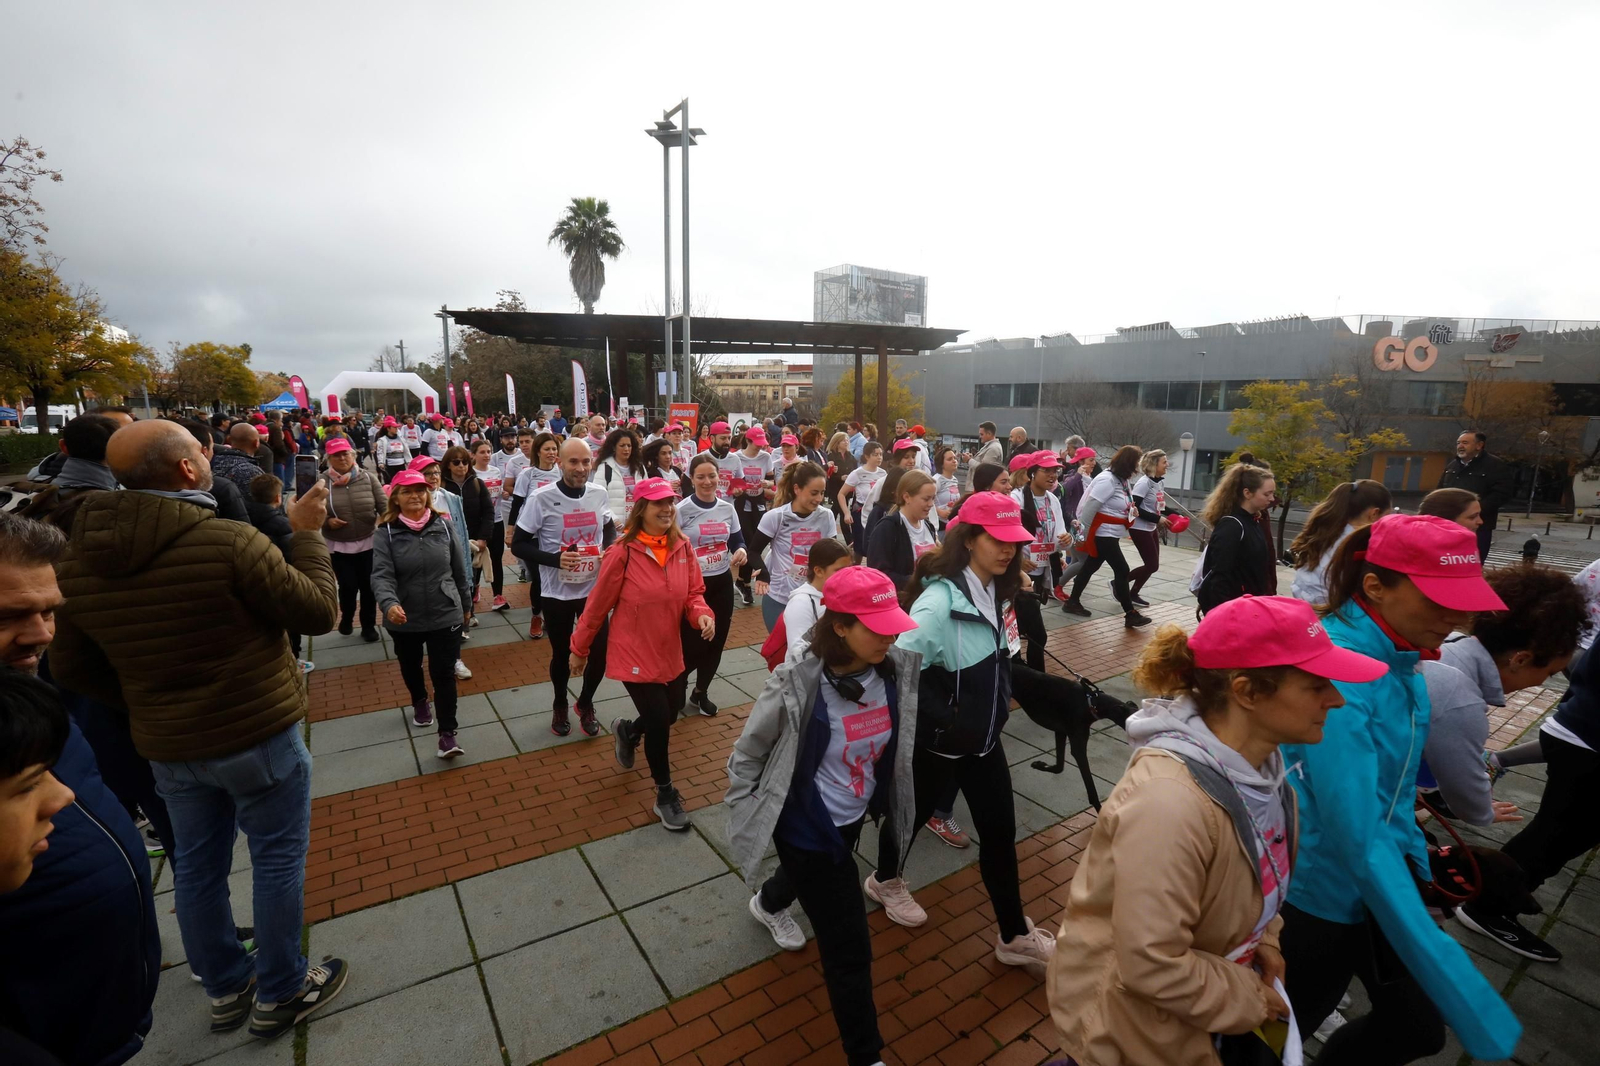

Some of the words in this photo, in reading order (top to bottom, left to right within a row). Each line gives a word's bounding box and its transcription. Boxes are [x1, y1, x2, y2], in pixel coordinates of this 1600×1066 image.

[1374, 335, 1438, 372] GO
[1429, 323, 1453, 344] fit
[706, 554, 721, 564] 1790
[569, 561, 595, 573] 278
[851, 722, 866, 731] PINK
